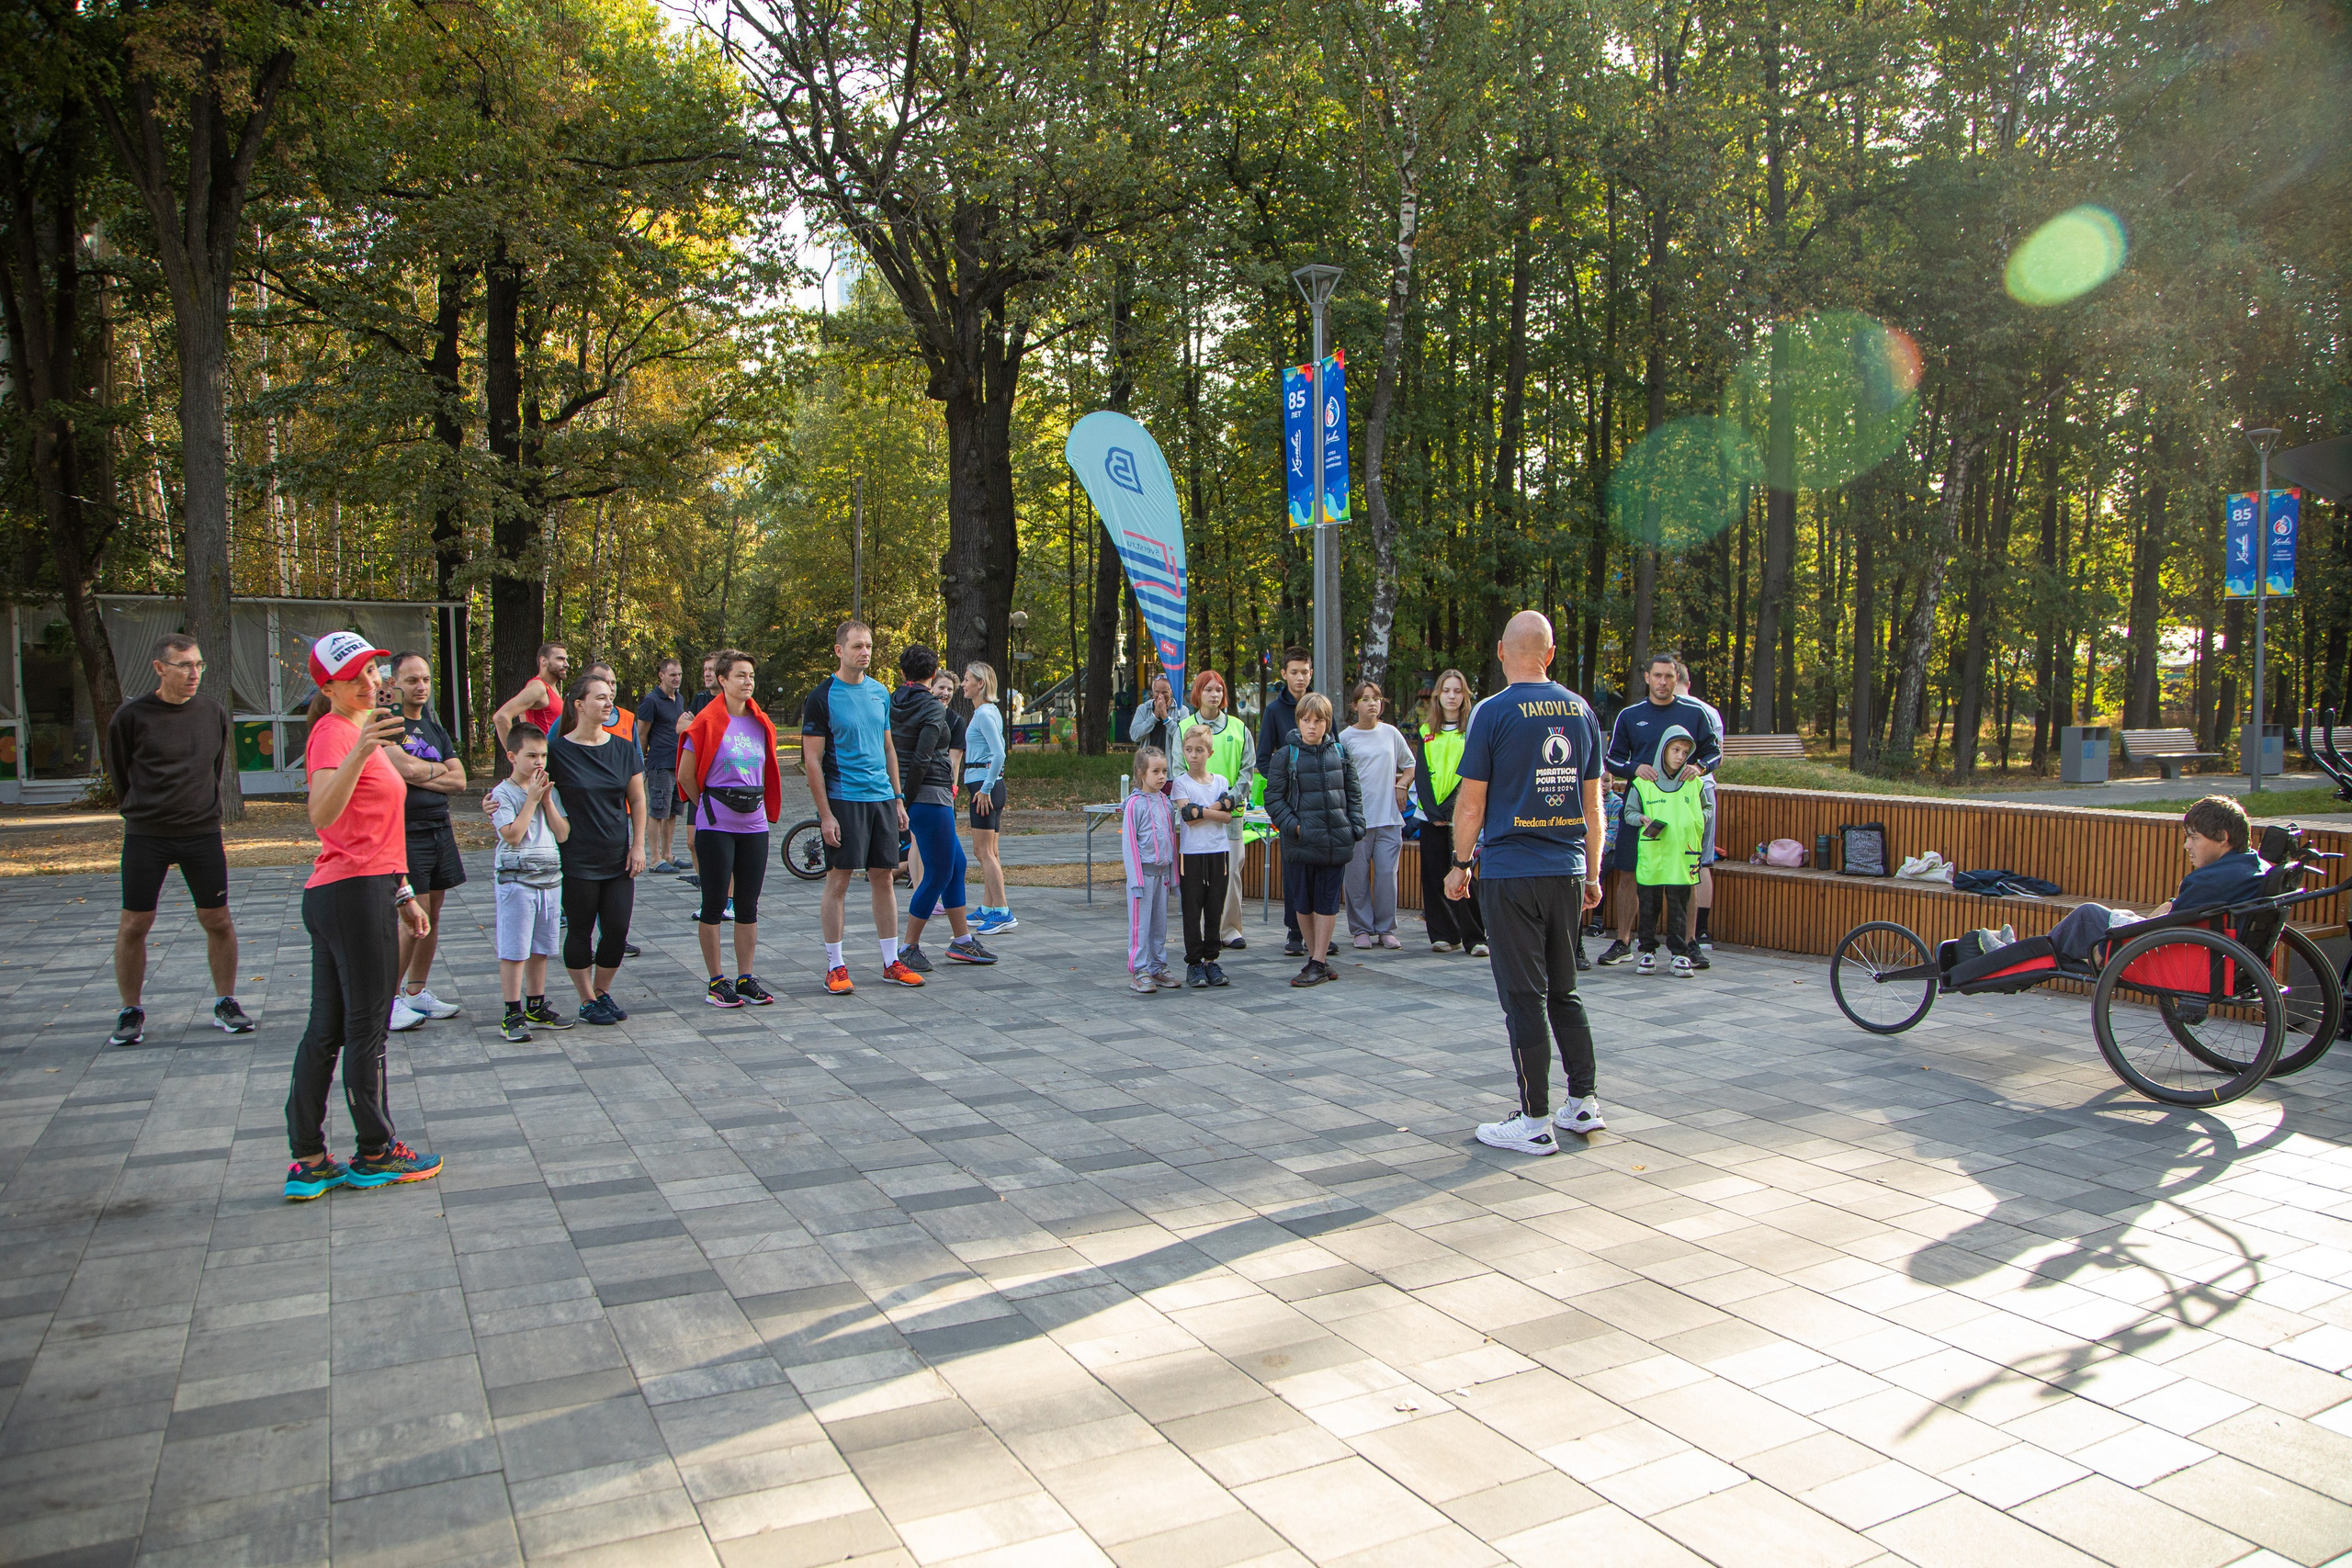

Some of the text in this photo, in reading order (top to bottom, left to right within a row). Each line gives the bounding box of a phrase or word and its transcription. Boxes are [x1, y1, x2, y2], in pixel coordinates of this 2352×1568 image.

[1288, 389, 1306, 410] 85
[1291, 411, 1301, 419] ЛЕТ
[2232, 508, 2252, 521] 85
[334, 642, 367, 662] ULTRA
[1518, 701, 1583, 717] YAKOVLEV
[1536, 767, 1577, 776] MARATHON
[1536, 775, 1577, 784] POUR TOUS
[1513, 816, 1585, 827] Freedom of Movemen
